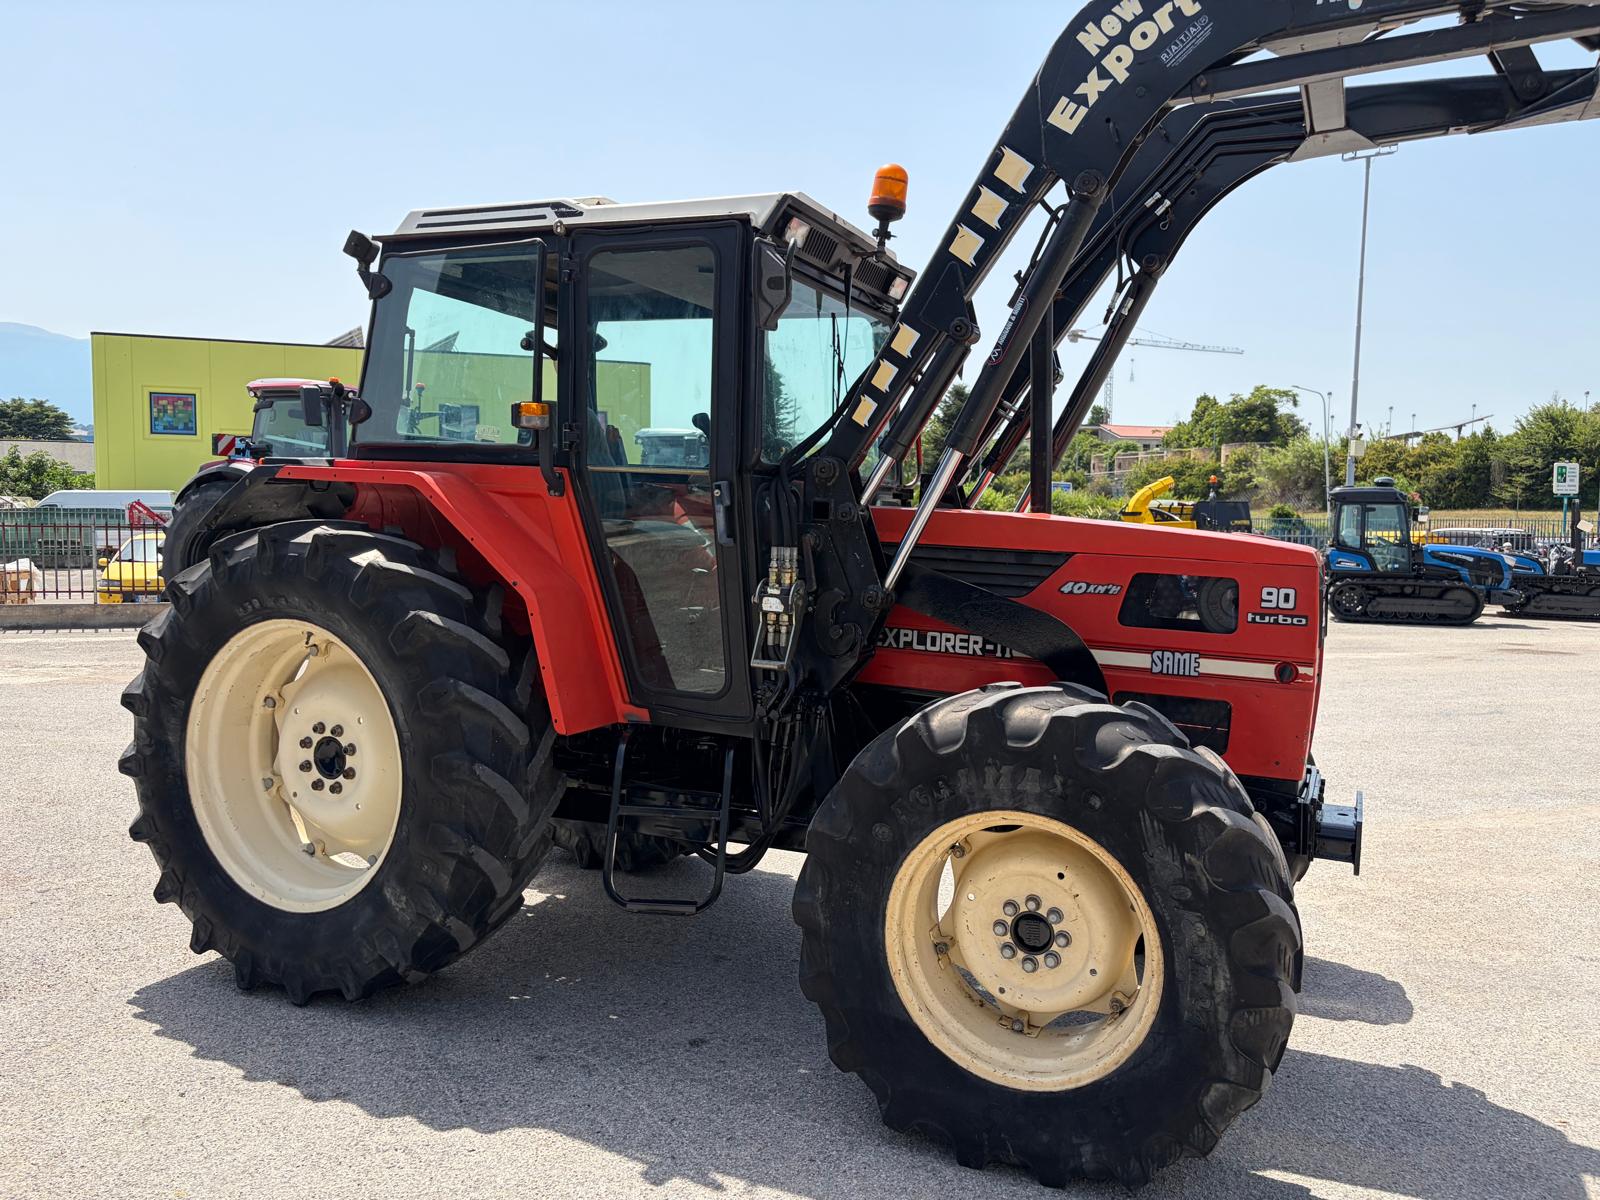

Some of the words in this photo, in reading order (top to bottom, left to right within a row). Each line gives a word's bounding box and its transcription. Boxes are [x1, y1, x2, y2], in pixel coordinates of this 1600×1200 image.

[1046, 0, 1202, 135] Export
[1260, 586, 1296, 609] 90
[1246, 612, 1308, 625] turbo
[1151, 650, 1200, 677] SAME
